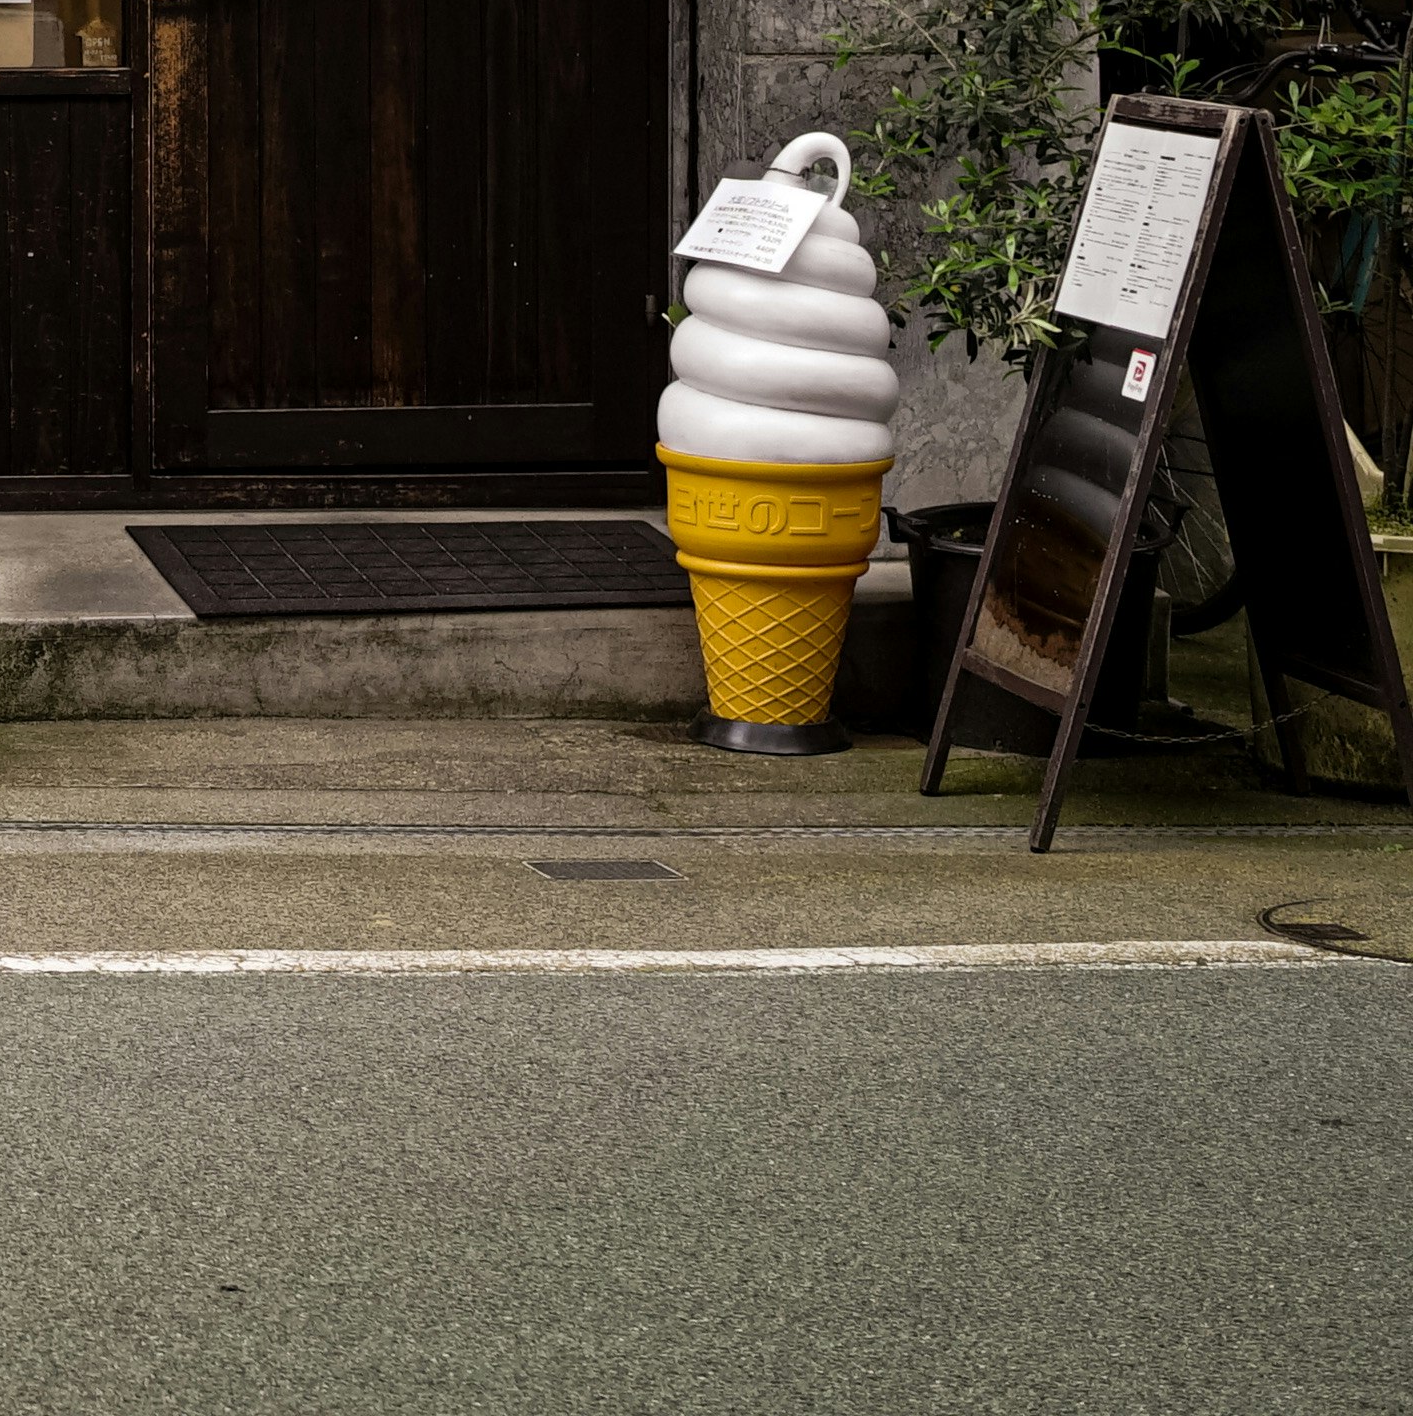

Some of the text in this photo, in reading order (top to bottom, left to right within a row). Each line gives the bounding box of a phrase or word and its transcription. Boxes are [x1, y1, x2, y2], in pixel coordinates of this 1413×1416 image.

[674, 486, 877, 535] 日世のコーン
